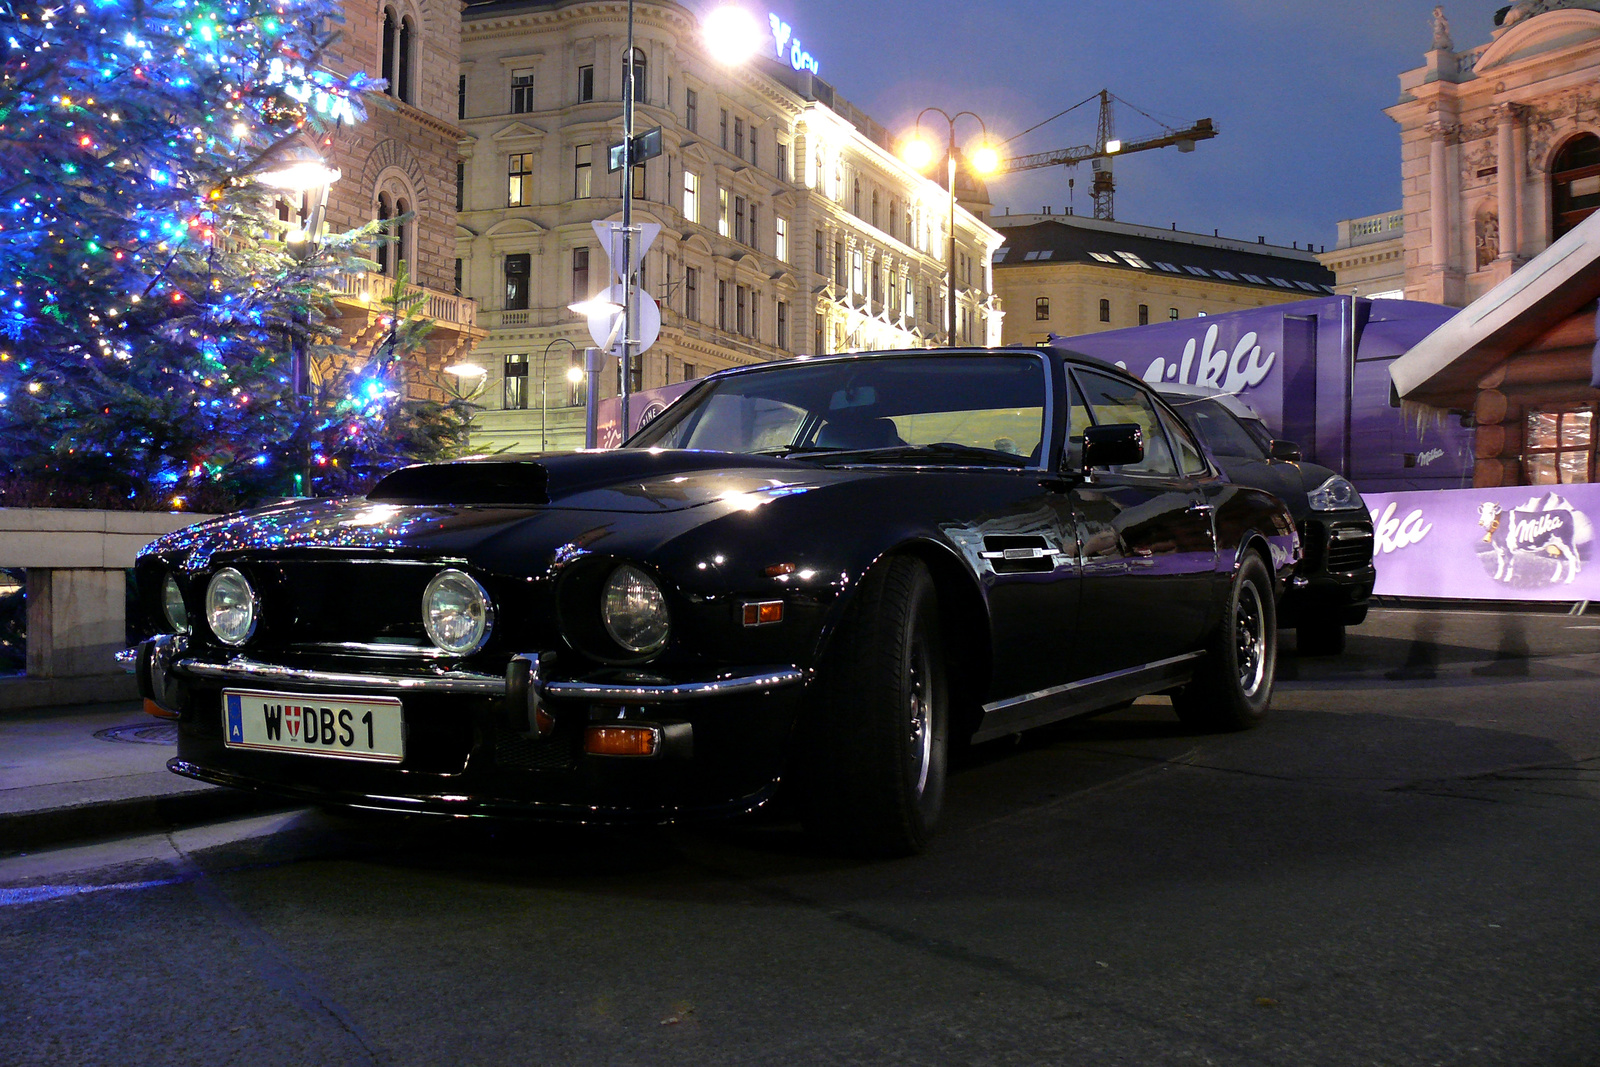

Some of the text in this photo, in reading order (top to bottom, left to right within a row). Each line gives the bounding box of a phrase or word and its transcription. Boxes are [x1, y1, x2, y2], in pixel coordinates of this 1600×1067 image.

[1417, 448, 1444, 467] Milka
[1513, 514, 1564, 543] Milka
[232, 724, 240, 736] A
[264, 703, 374, 749] W DBS 1
